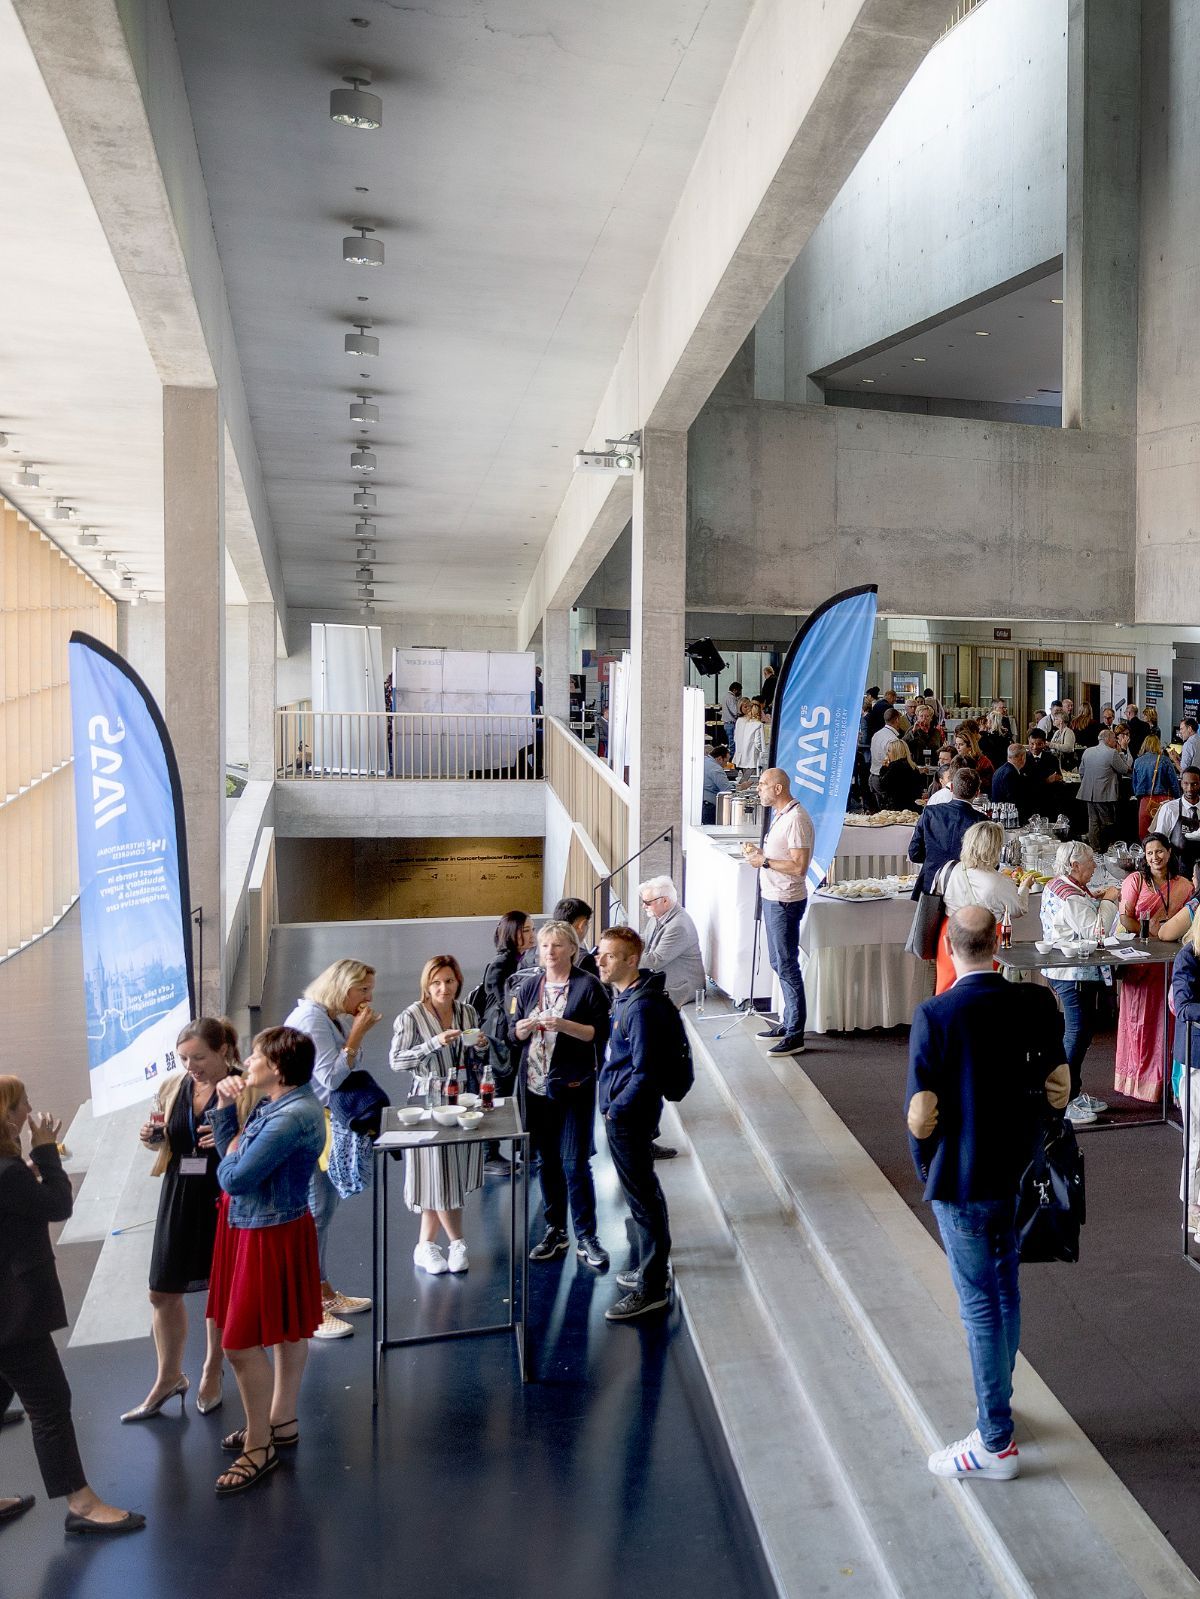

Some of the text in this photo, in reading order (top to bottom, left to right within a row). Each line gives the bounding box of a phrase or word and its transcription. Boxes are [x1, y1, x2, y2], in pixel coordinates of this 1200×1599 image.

[840, 708, 848, 737] SURGERY
[795, 706, 831, 795] IAAS
[828, 750, 838, 796] INTERNATIONAL
